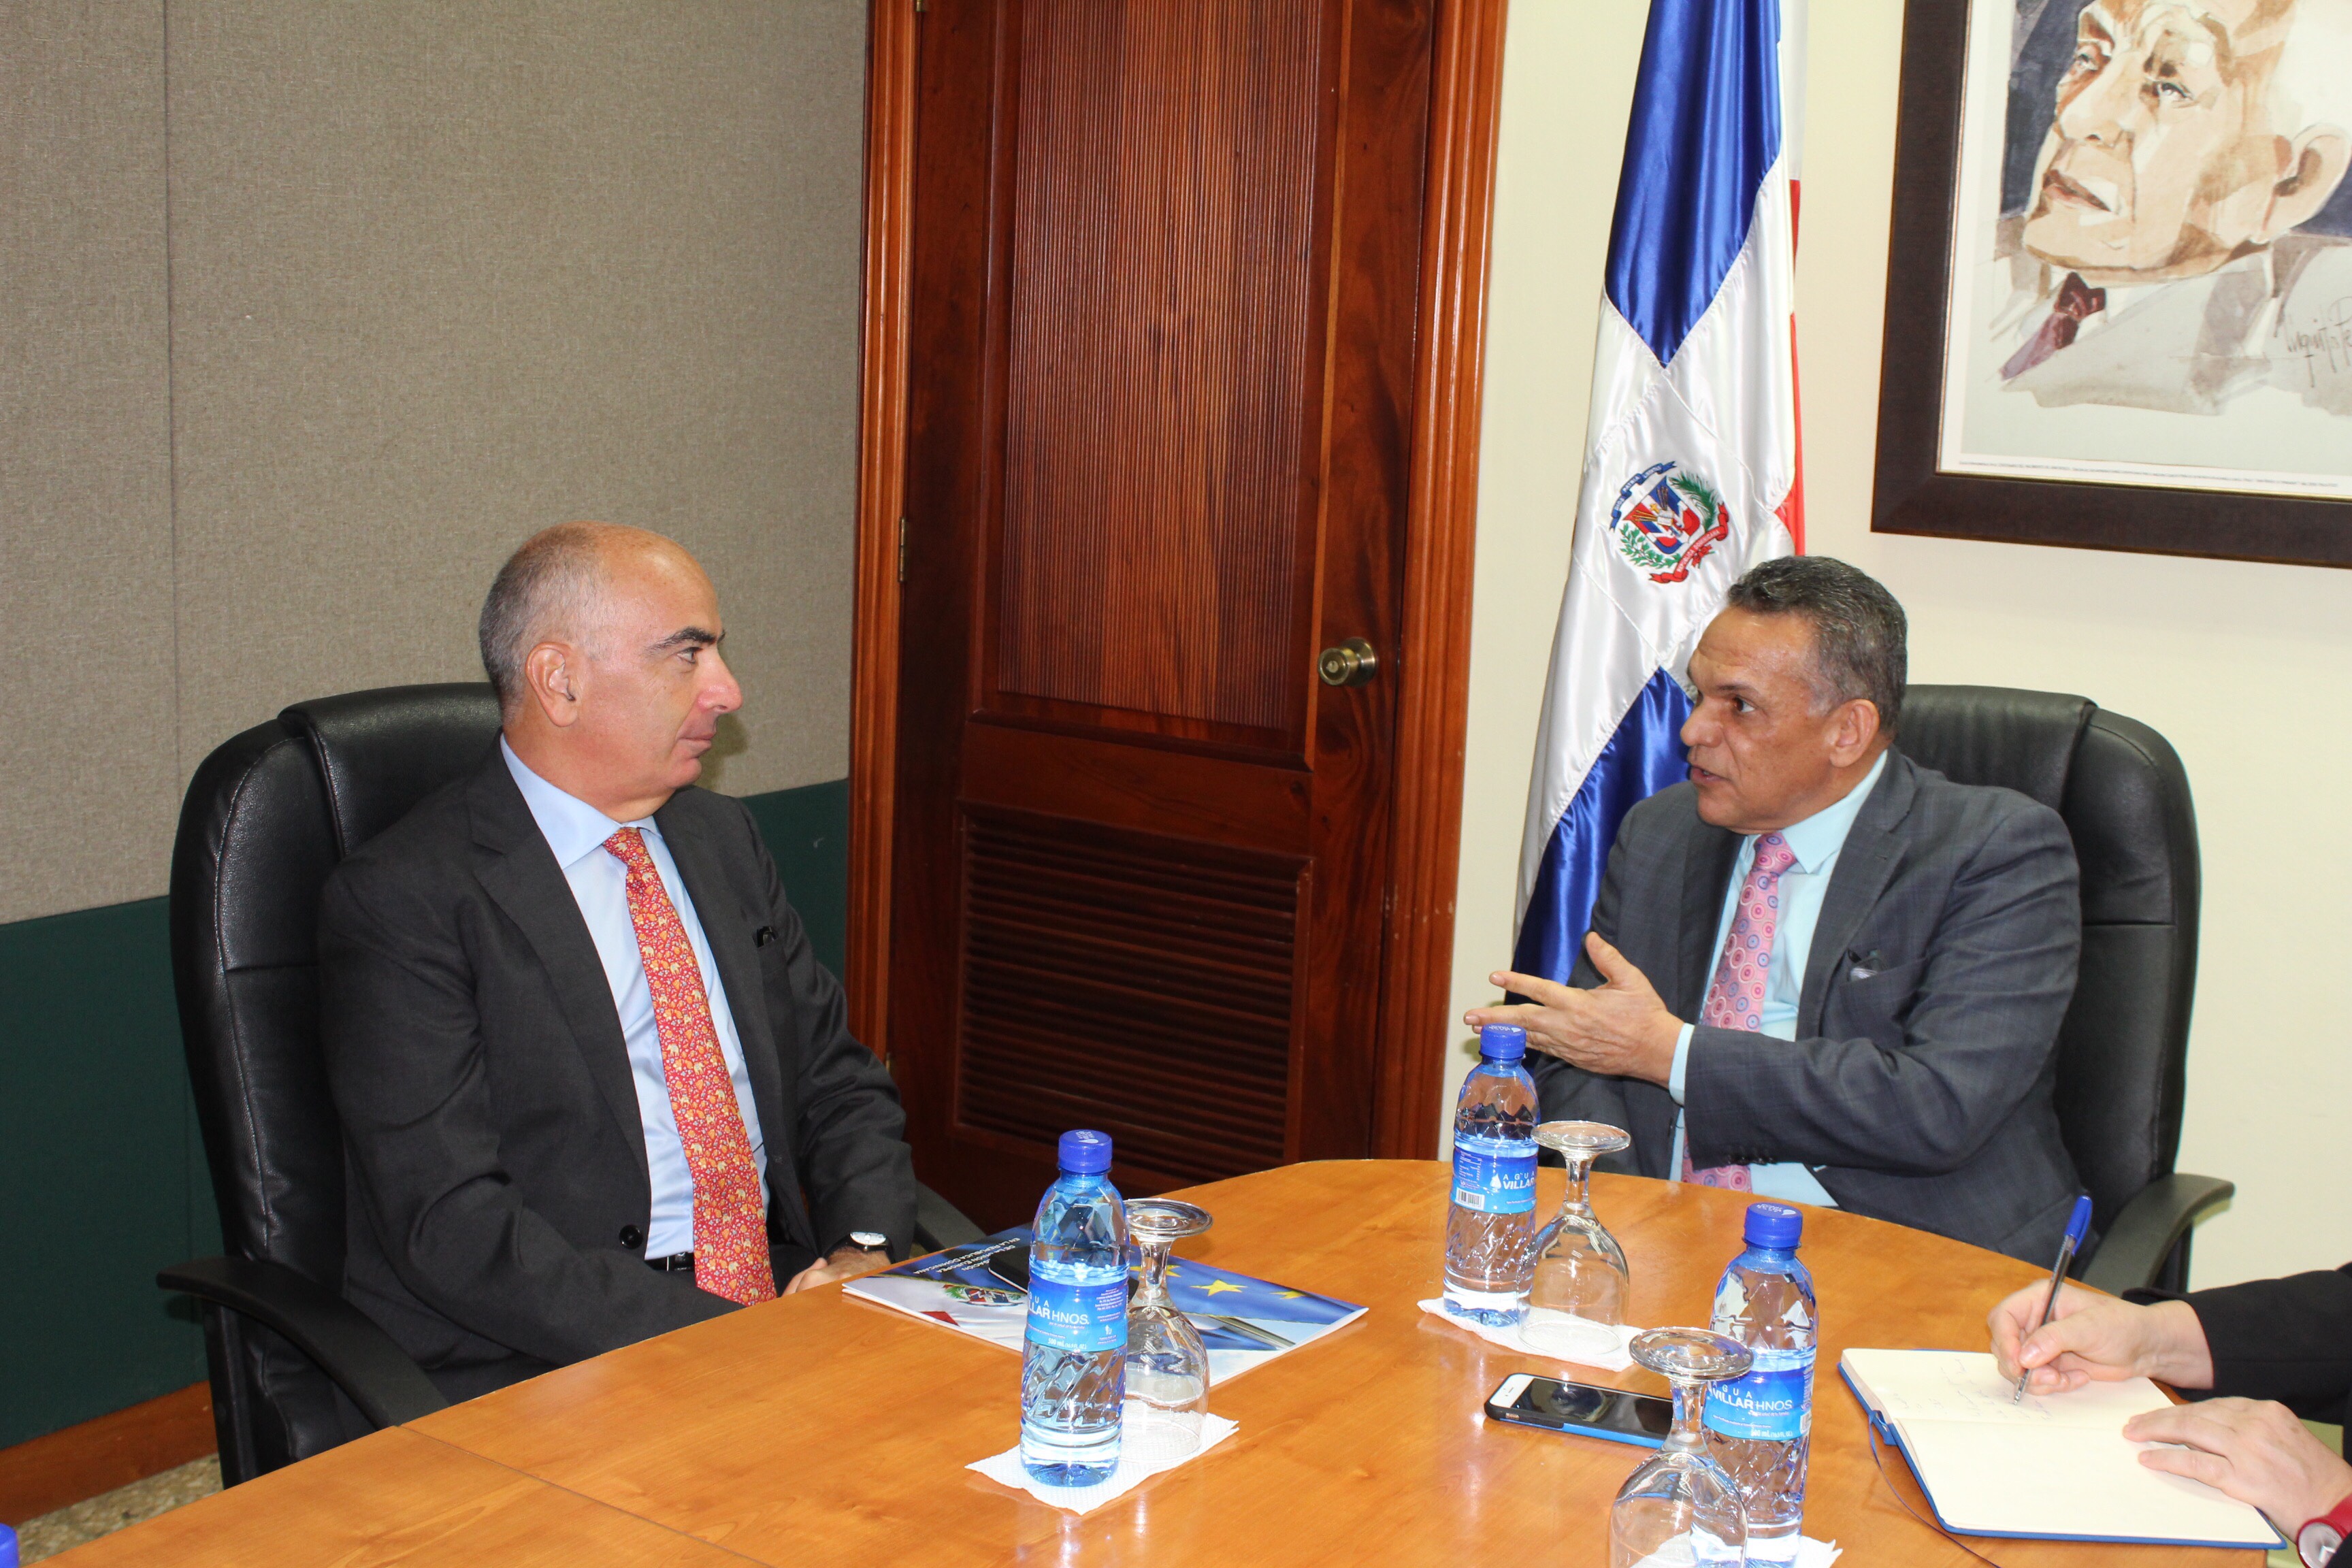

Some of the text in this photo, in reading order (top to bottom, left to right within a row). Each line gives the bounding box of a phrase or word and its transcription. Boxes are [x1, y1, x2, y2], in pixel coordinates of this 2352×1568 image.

[913, 1258, 961, 1274] DOMINICANA
[936, 1260, 973, 1273] EUROPEA
[1048, 1337, 1057, 1345] 500
[1712, 1380, 1752, 1399] AGUA
[1712, 1388, 1754, 1409] VILLAR
